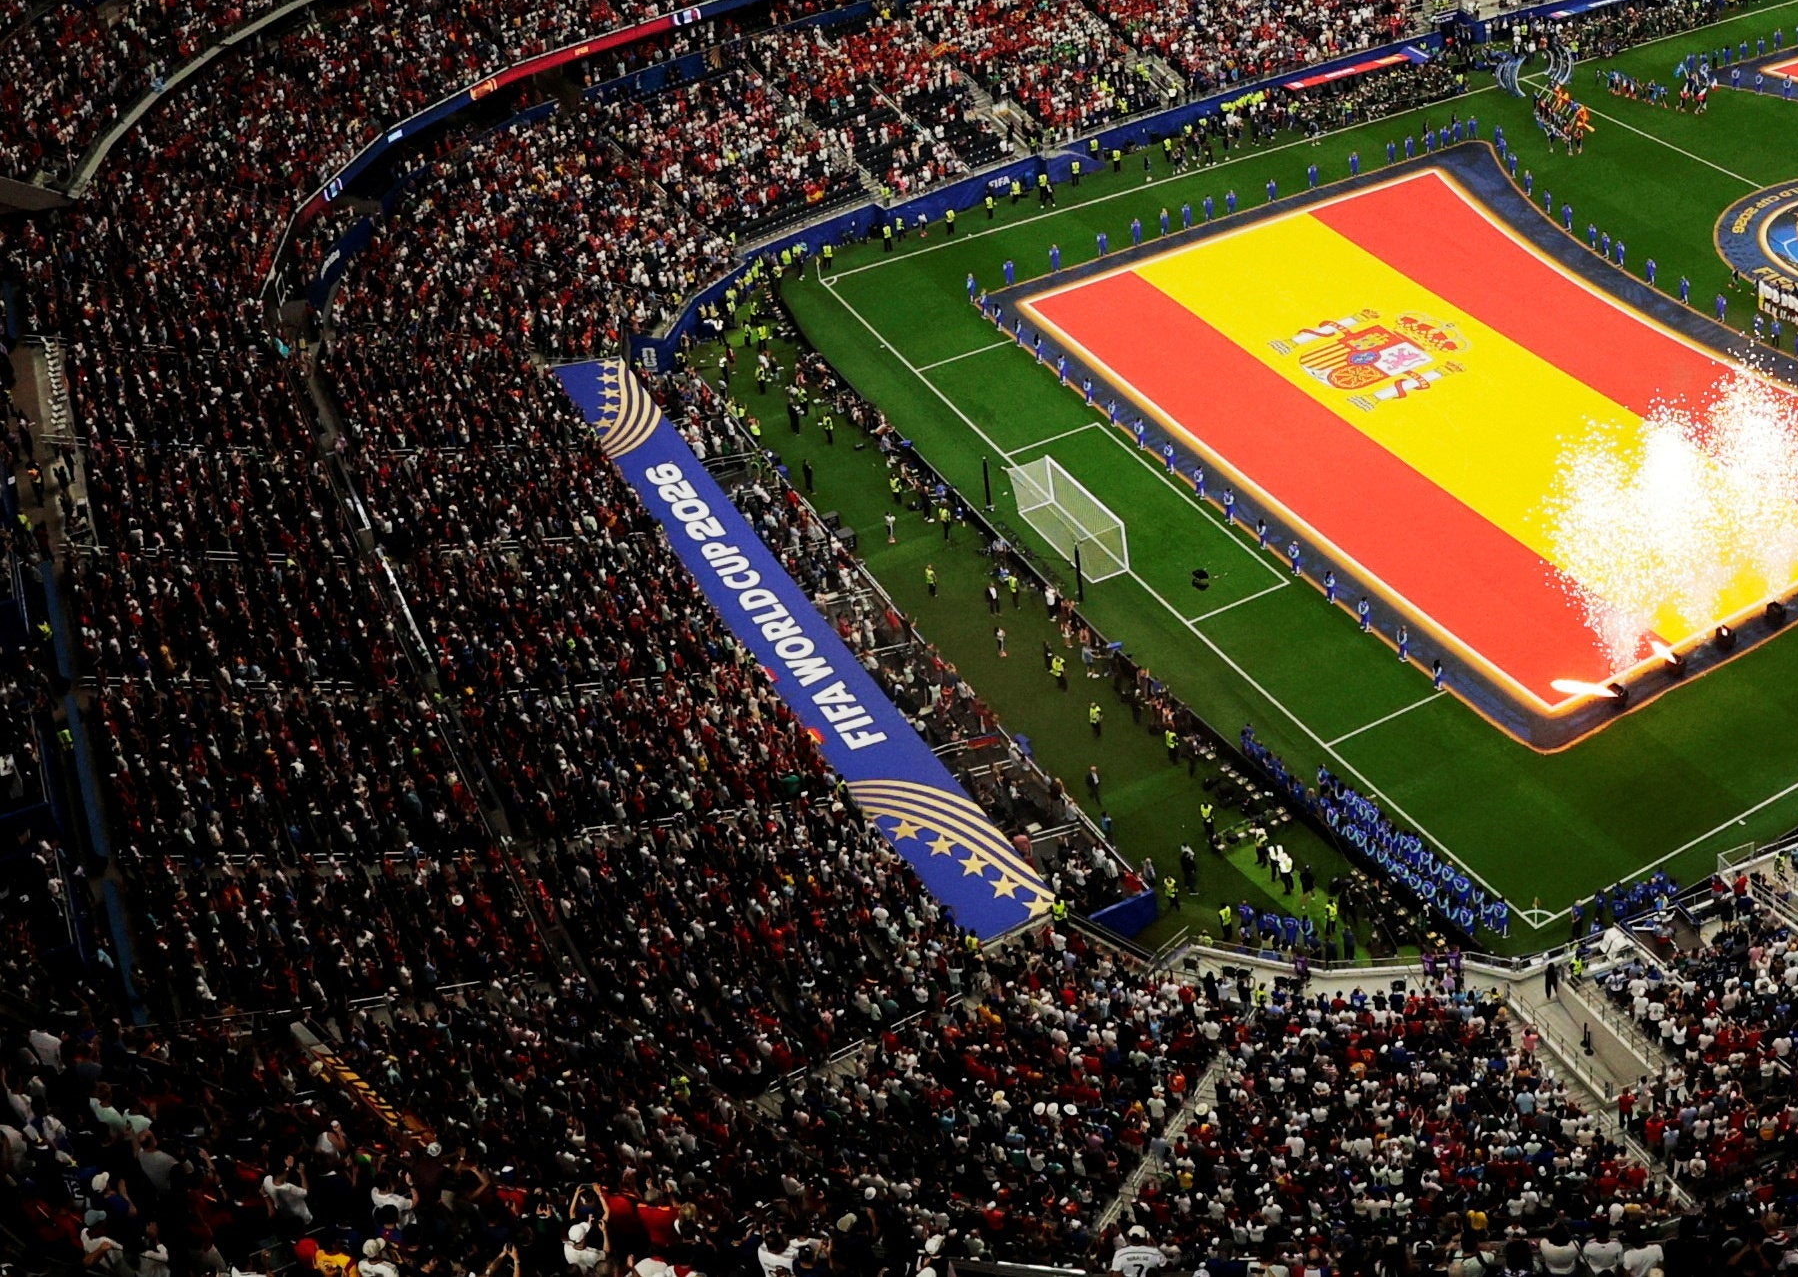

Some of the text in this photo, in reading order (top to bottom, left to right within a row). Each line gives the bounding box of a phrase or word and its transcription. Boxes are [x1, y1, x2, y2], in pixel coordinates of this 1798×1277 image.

[988, 176, 1011, 189] FIFA
[1755, 195, 1780, 209] CUP
[1731, 204, 1758, 234] 2026
[645, 462, 889, 752] FIFA WORLD CUP 2026
